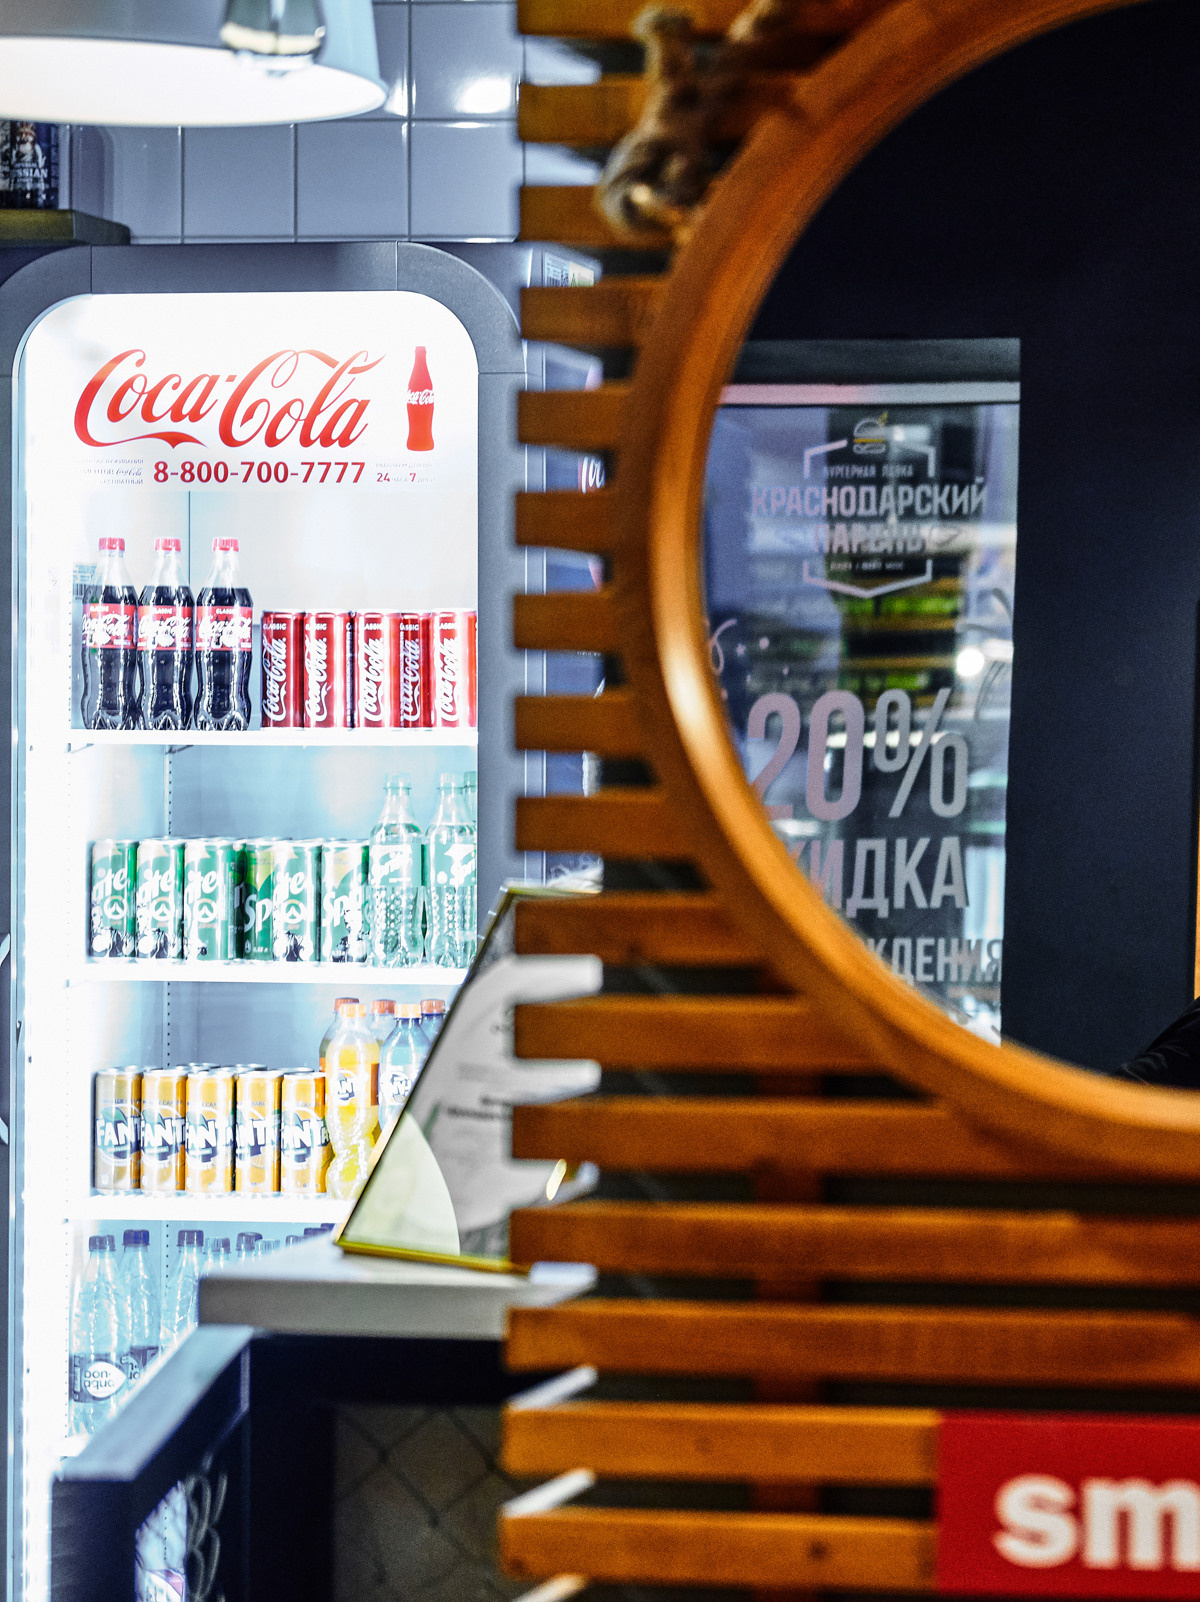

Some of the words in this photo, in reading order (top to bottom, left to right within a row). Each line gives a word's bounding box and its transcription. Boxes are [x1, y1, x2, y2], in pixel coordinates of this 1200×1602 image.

[74, 349, 387, 449] Coca-Cola
[153, 460, 366, 484] 8-800-700-7777
[376, 472, 391, 483] 24
[409, 472, 417, 483] 7
[752, 477, 988, 517] КРАСНОДАРСКИЙ
[748, 688, 969, 820] 20%
[790, 837, 969, 919] ИДКА
